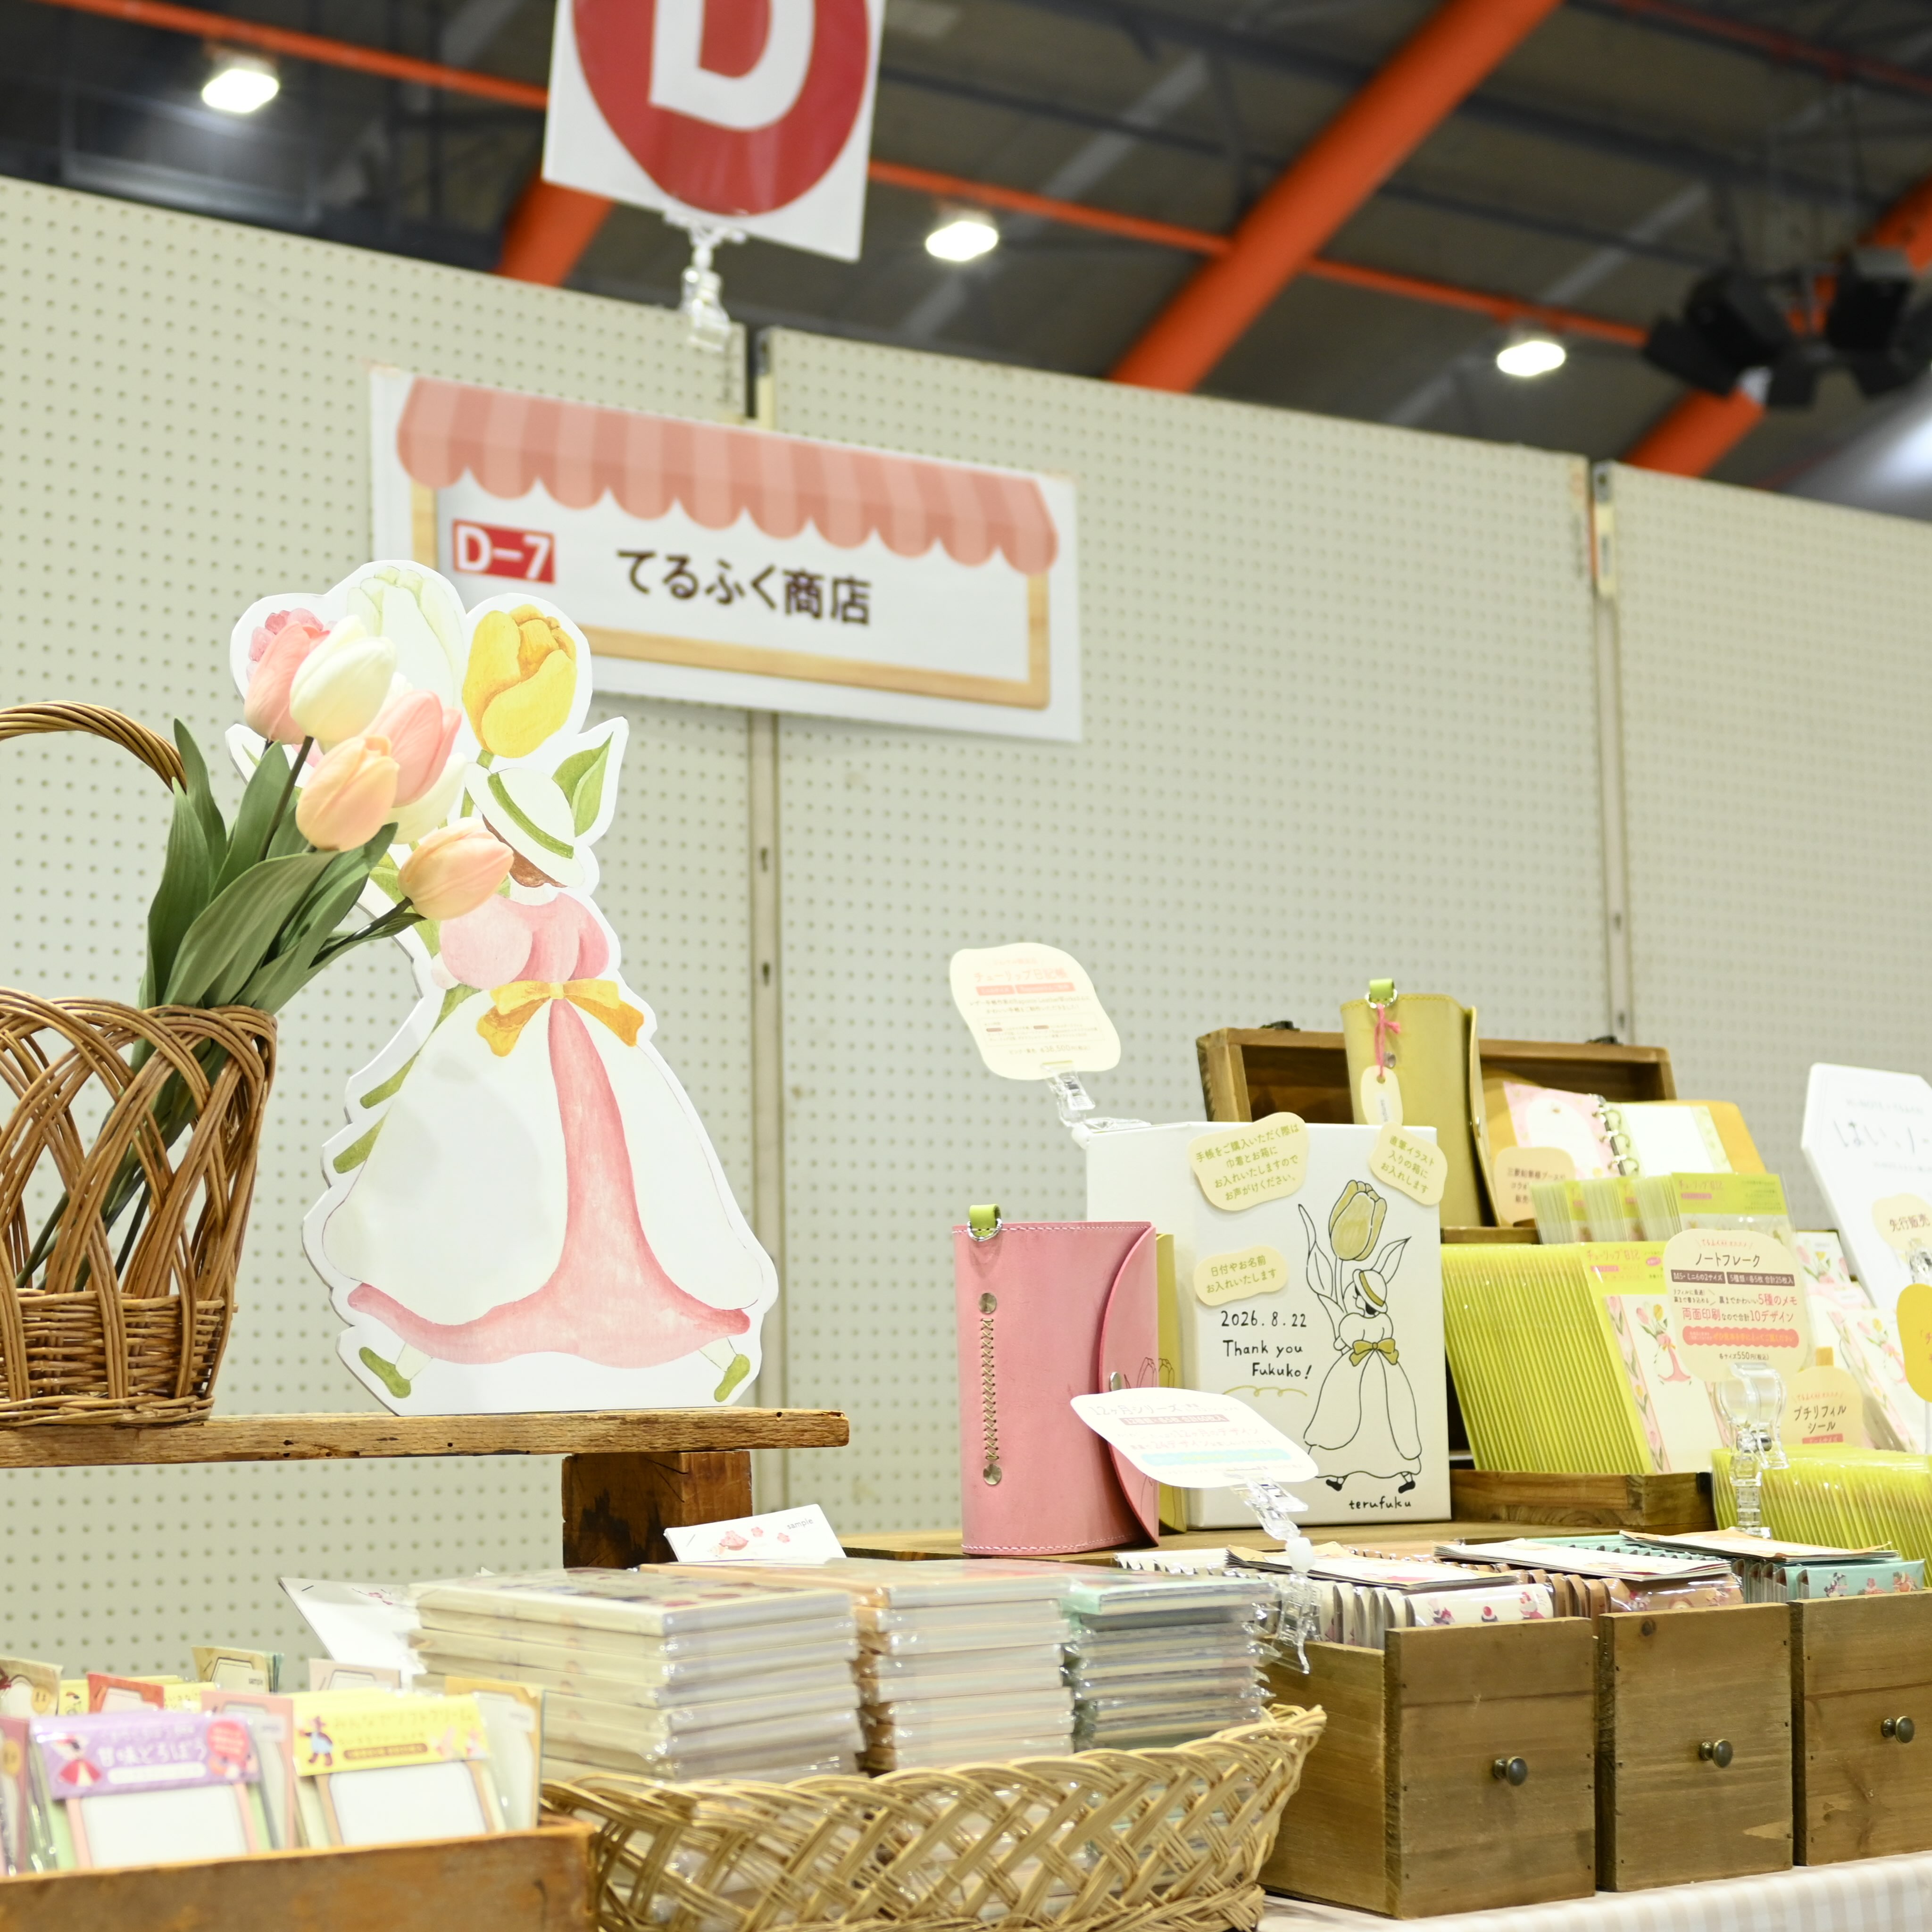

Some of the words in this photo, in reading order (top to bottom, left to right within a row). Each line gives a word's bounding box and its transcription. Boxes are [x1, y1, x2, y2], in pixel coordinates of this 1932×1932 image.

[647, 0, 817, 131] D
[616, 549, 871, 626] てるふく商店
[1196, 1124, 1299, 1163] 手帳をご購入いただく際は
[1390, 1135, 1435, 1166] 直筆イラスト
[1226, 1147, 1278, 1168] 巾着とお箱に
[1388, 1150, 1428, 1179] 入りの箱に
[1215, 1154, 1299, 1188] お入れいたしますので
[1381, 1162, 1429, 1194] お入れします
[1225, 1173, 1296, 1201] お声がけください。
[1889, 1213, 1931, 1232] 先行販売
[1210, 1255, 1267, 1277] 日付やお名前
[1696, 1252, 1760, 1267] ノートフレーク
[1206, 1268, 1277, 1293] お入れいたします
[1222, 1338, 1269, 1357] Thank
[1276, 1344, 1303, 1358] you
[1793, 1404, 1847, 1421] プチリフィル
[1807, 1421, 1836, 1434] シール
[1349, 1496, 1411, 1509] terufuku
[787, 1517, 814, 1530] sample
